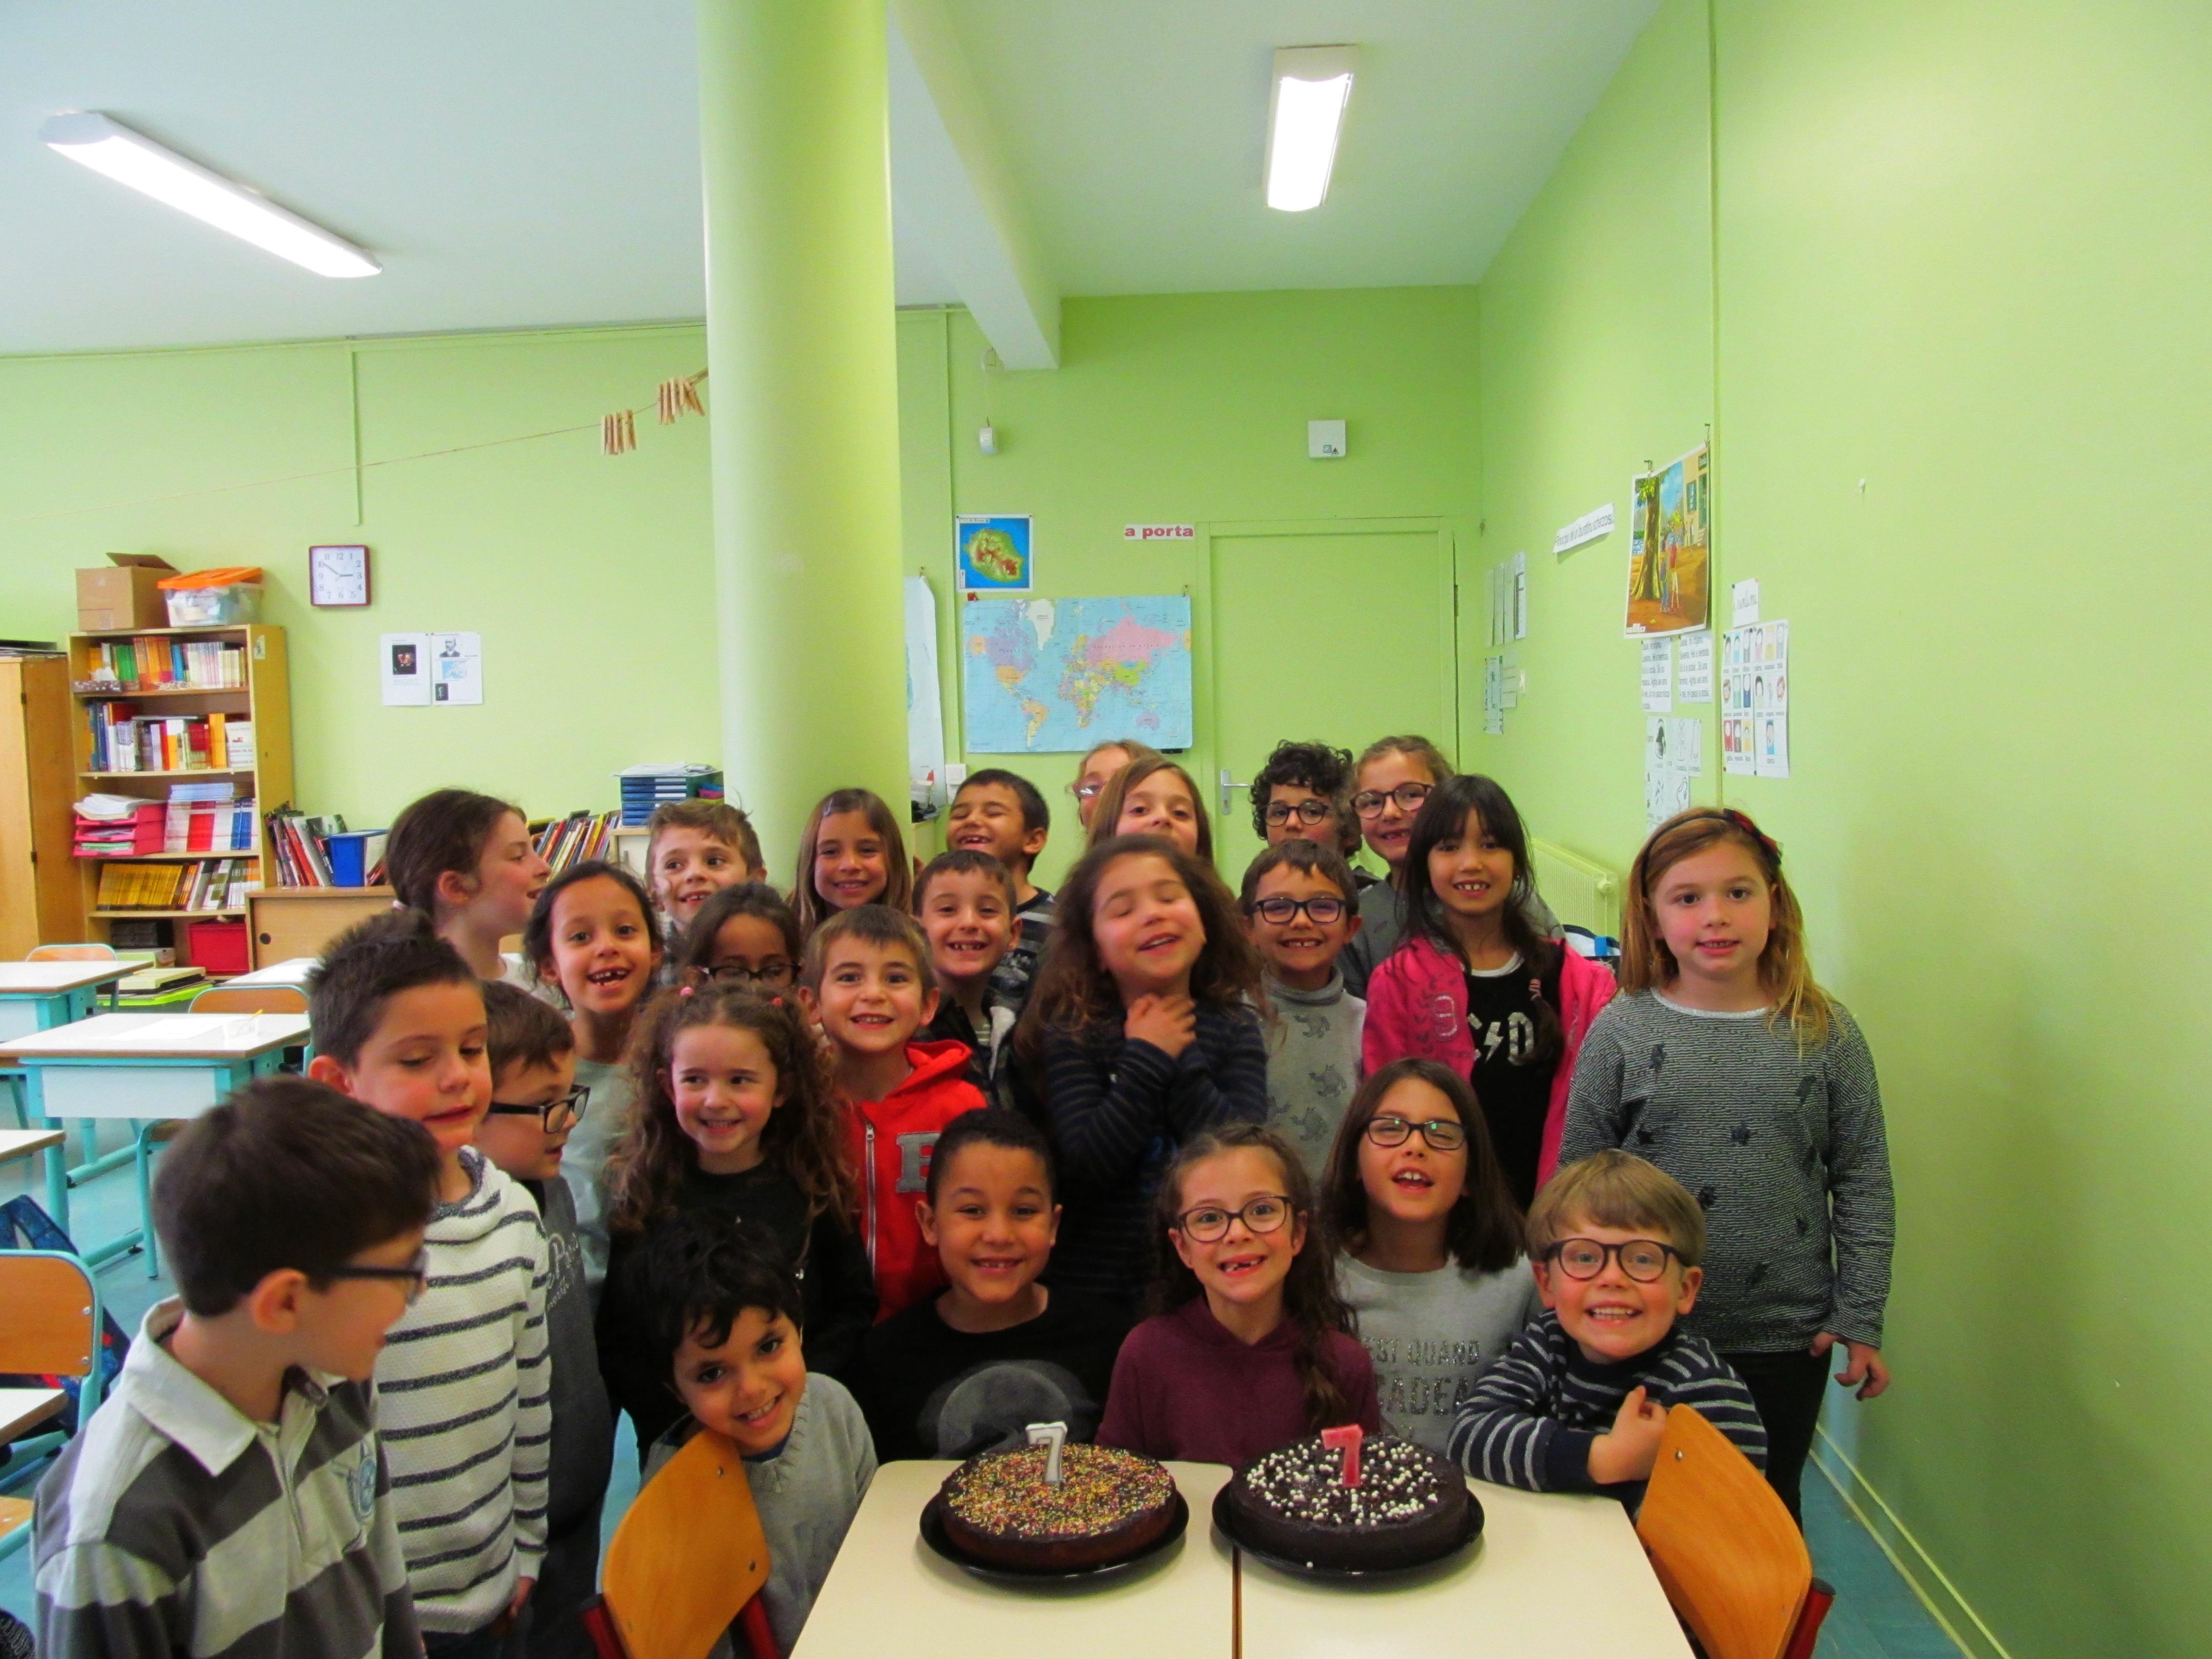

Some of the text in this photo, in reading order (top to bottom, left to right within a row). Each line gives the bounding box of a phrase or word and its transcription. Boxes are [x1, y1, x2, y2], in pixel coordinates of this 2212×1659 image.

[1124, 526, 1194, 539] a porta
[1025, 1421, 1068, 1485] 7
[1321, 1423, 1364, 1488] 7
